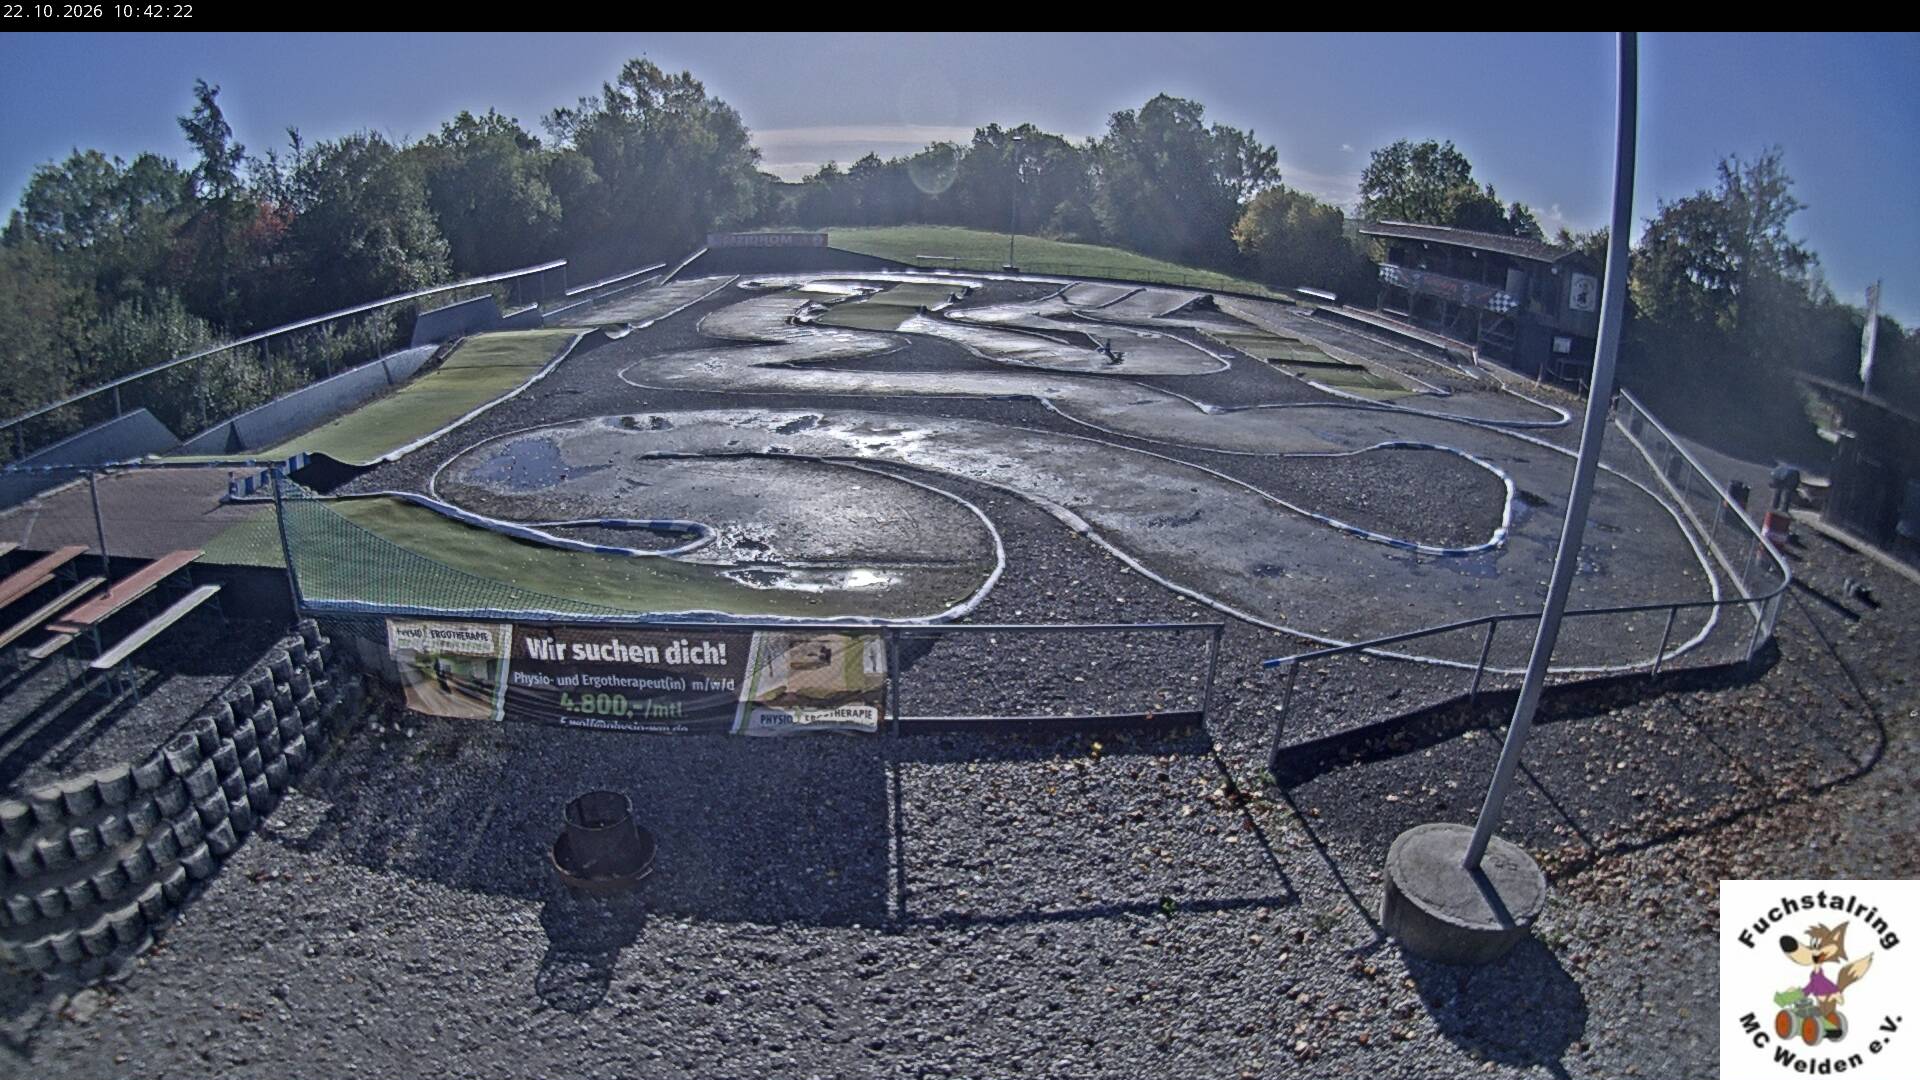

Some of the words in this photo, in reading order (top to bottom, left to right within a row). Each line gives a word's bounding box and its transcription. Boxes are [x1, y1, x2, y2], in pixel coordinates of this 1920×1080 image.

[525, 636, 567, 661] Wir
[572, 638, 660, 664] suchen
[664, 638, 728, 666] dich!
[513, 671, 555, 687] Physio-
[557, 673, 579, 687] und
[582, 673, 686, 692] Ergotherapeut(in)
[691, 676, 735, 692] m/w/d
[760, 713, 794, 725] PHYSIO
